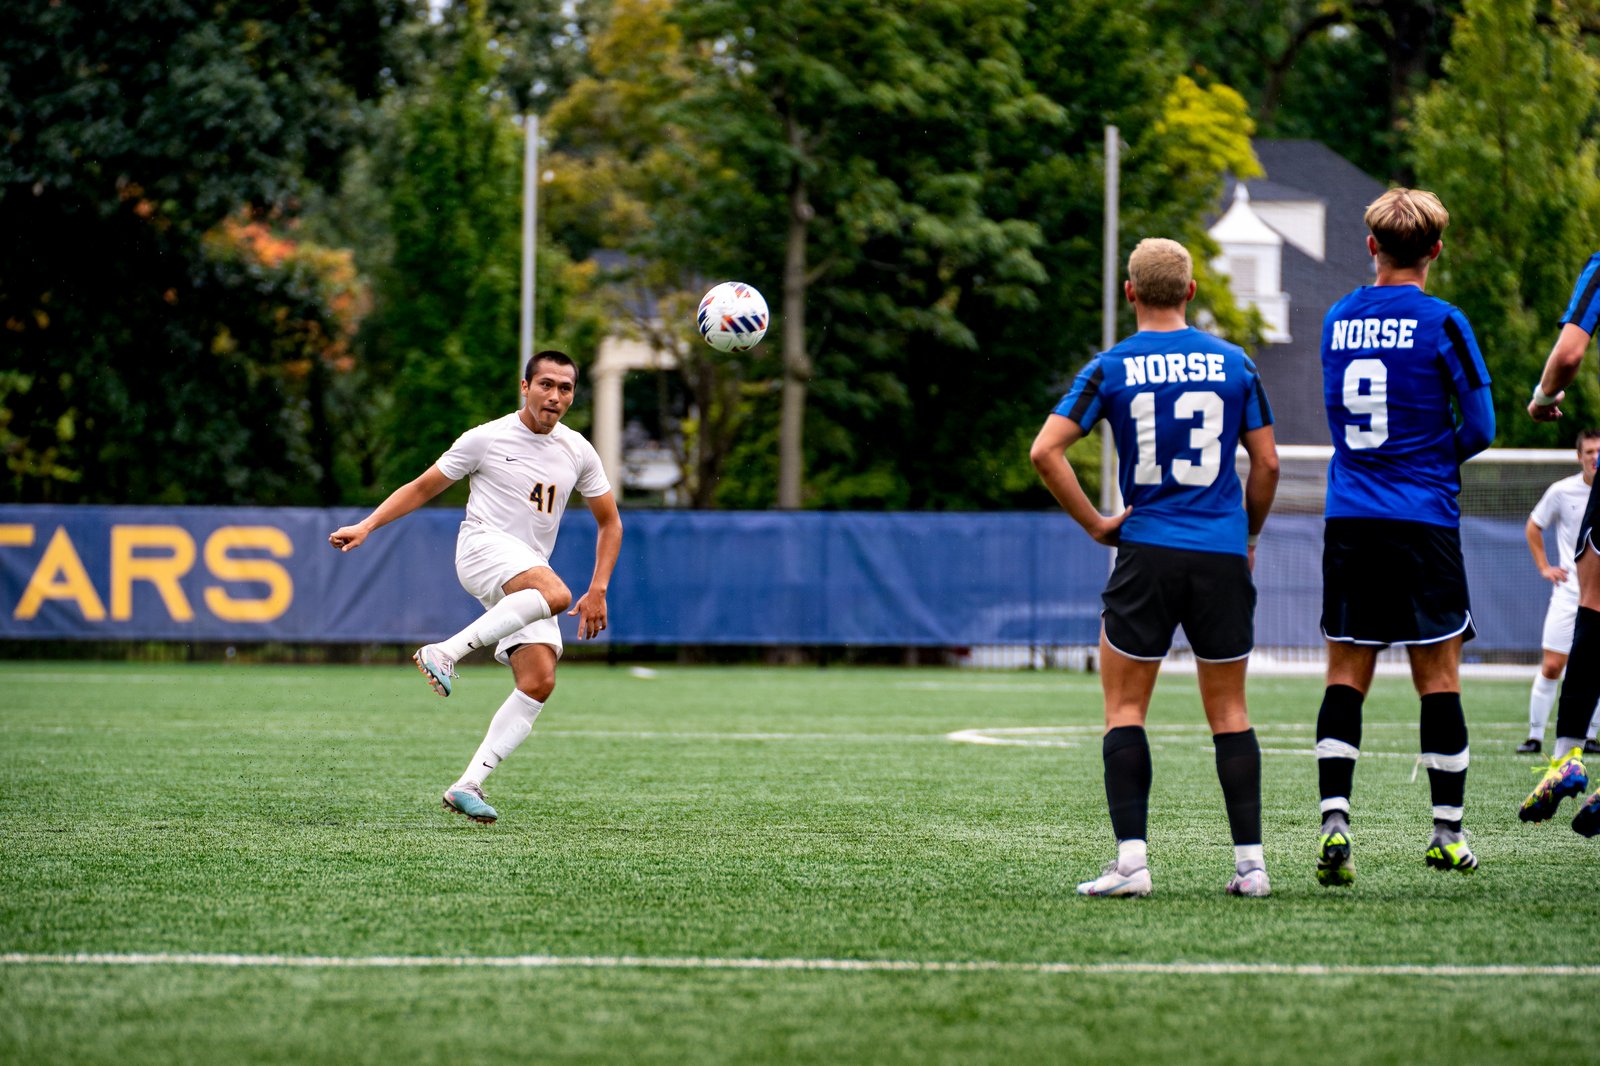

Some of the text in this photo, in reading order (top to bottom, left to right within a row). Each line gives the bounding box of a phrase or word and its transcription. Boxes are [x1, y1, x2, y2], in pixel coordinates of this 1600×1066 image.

[1331, 318, 1418, 350] NORSE
[1123, 352, 1226, 386] NORSE
[1342, 358, 1389, 450] 9
[1130, 391, 1224, 487] 13
[529, 482, 557, 515] 41
